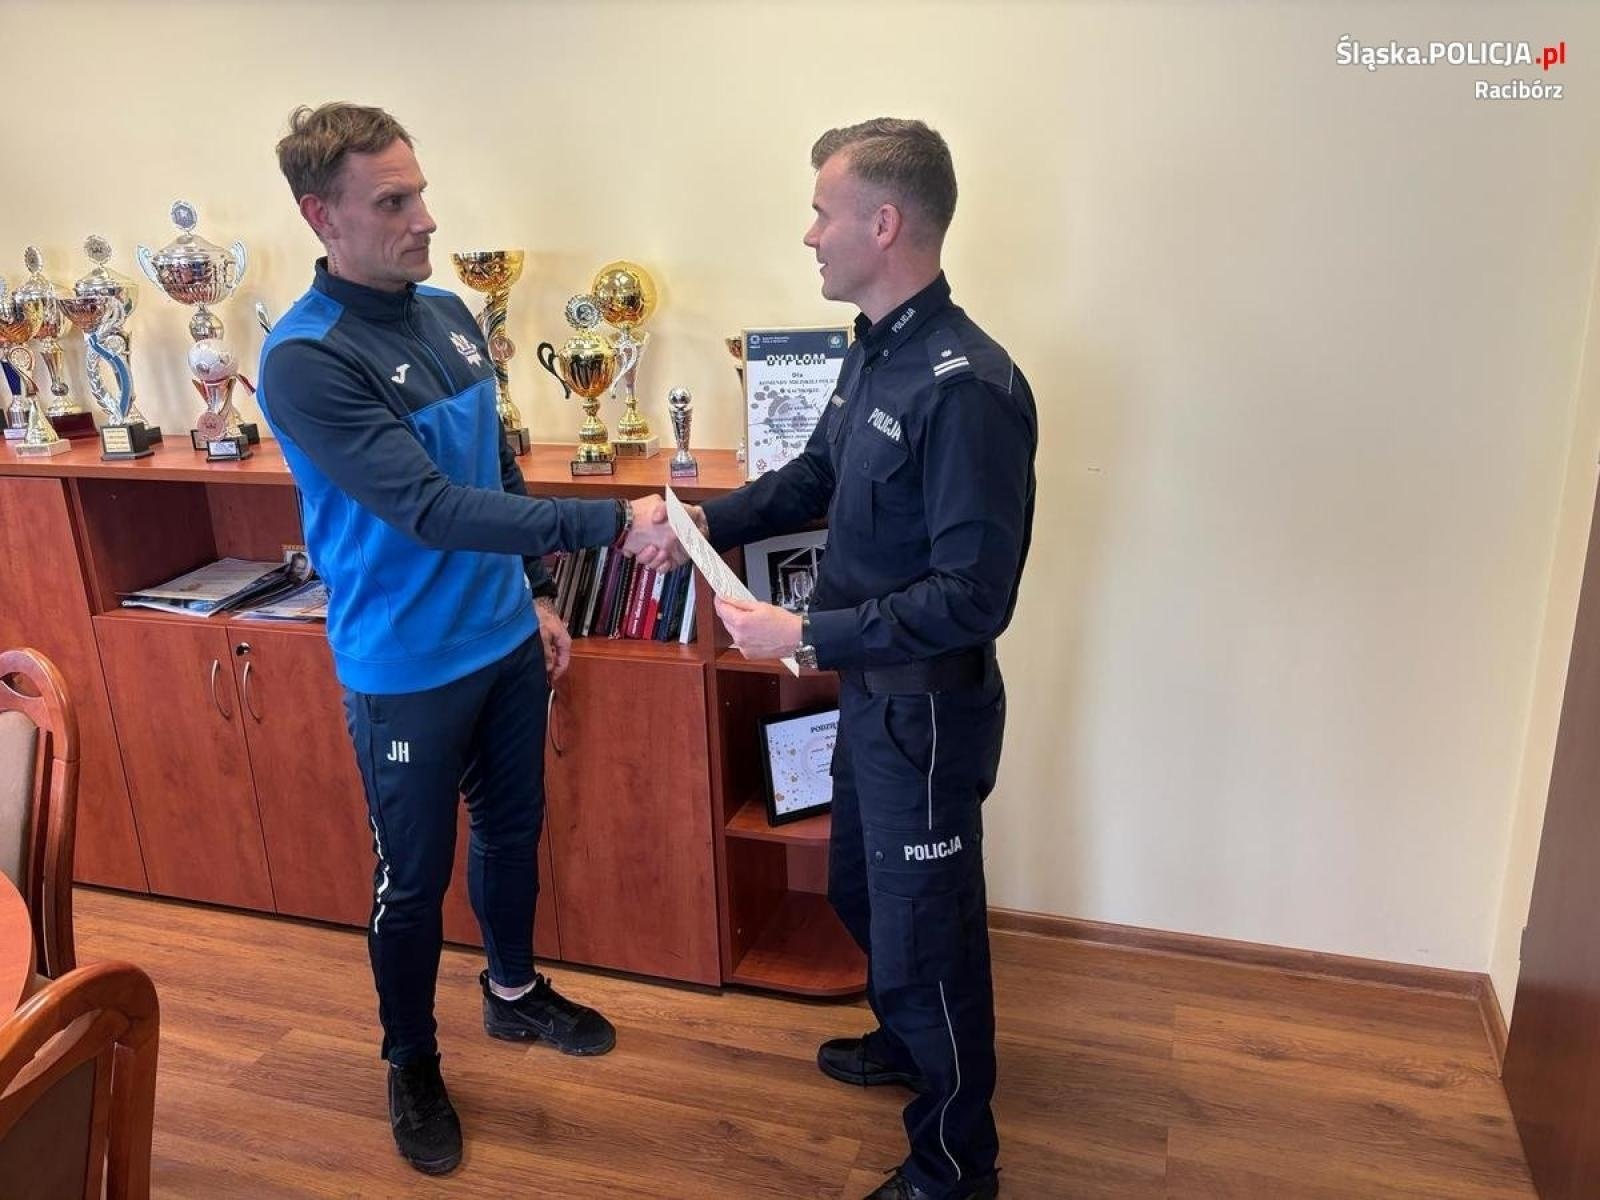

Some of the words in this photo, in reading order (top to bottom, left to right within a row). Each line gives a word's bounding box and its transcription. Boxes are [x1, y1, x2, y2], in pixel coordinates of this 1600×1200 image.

[891, 307, 916, 333] POLICJA
[766, 353, 827, 366] DYPLOM
[867, 407, 902, 441] POLICJA
[387, 740, 409, 763] JH
[903, 835, 962, 861] POLICJA
